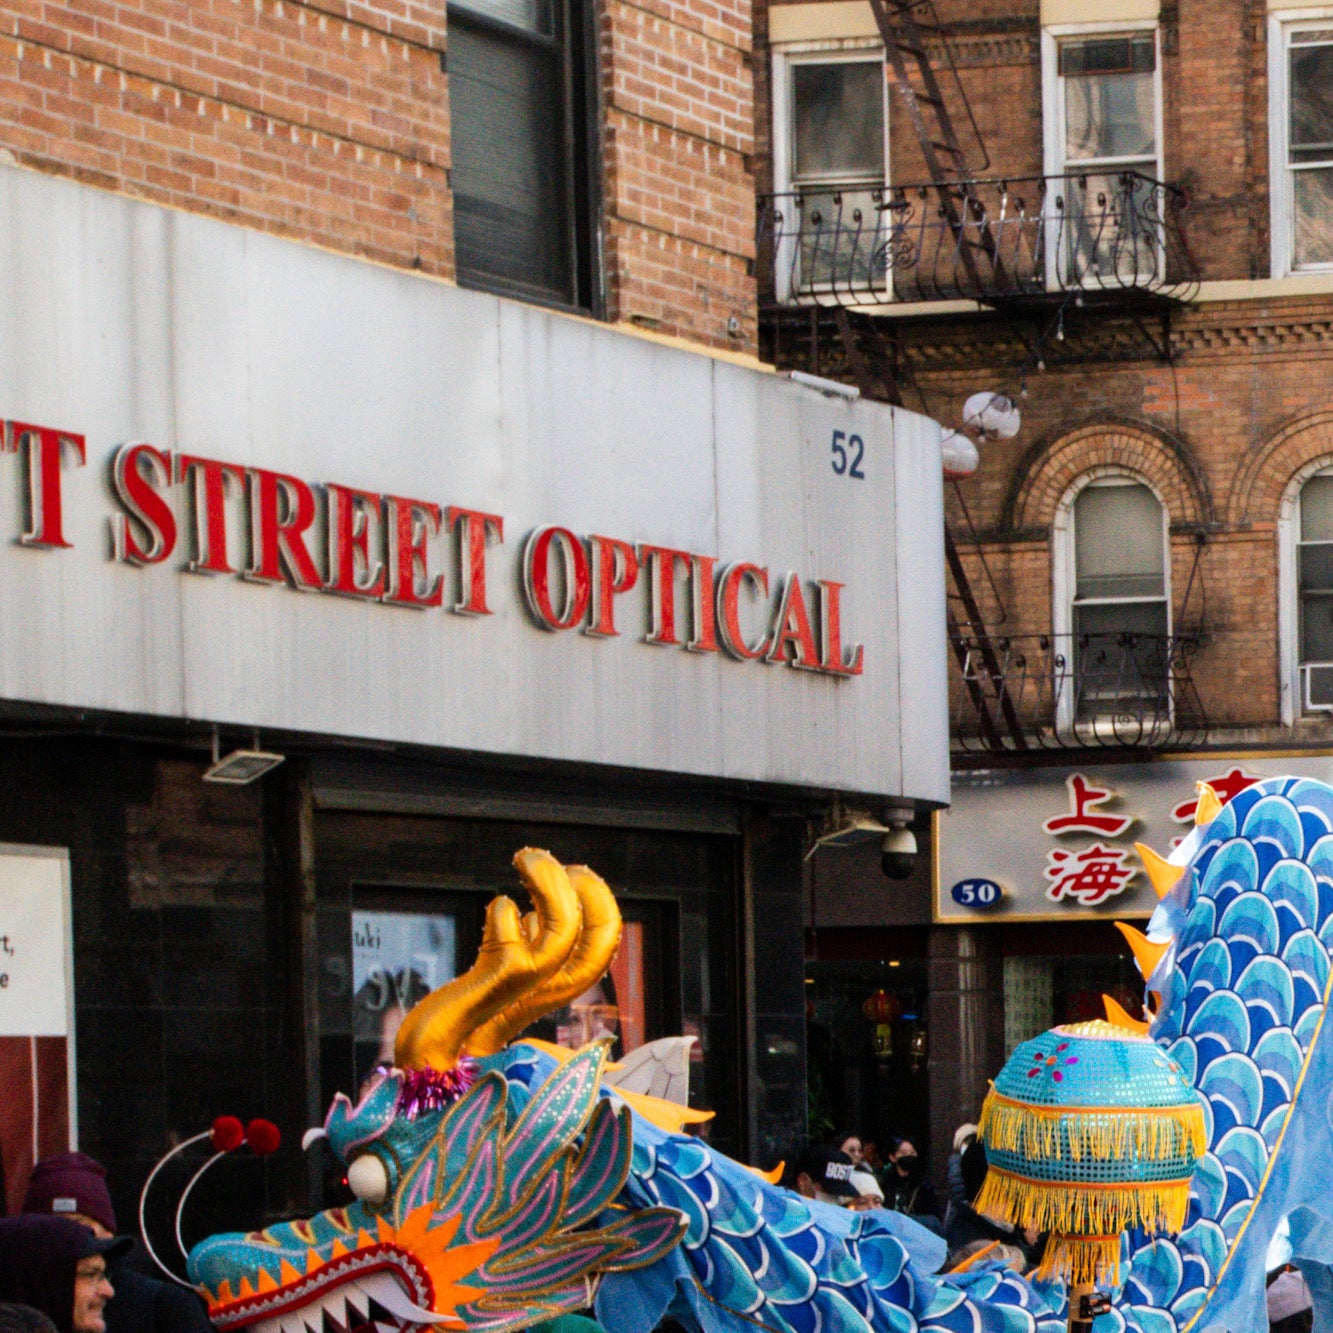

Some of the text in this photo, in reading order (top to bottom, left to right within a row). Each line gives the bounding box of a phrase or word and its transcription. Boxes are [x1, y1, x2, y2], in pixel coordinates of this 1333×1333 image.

[831, 430, 865, 480] 52
[0, 418, 864, 677] T STREET OPTICAL
[960, 883, 996, 903] 50
